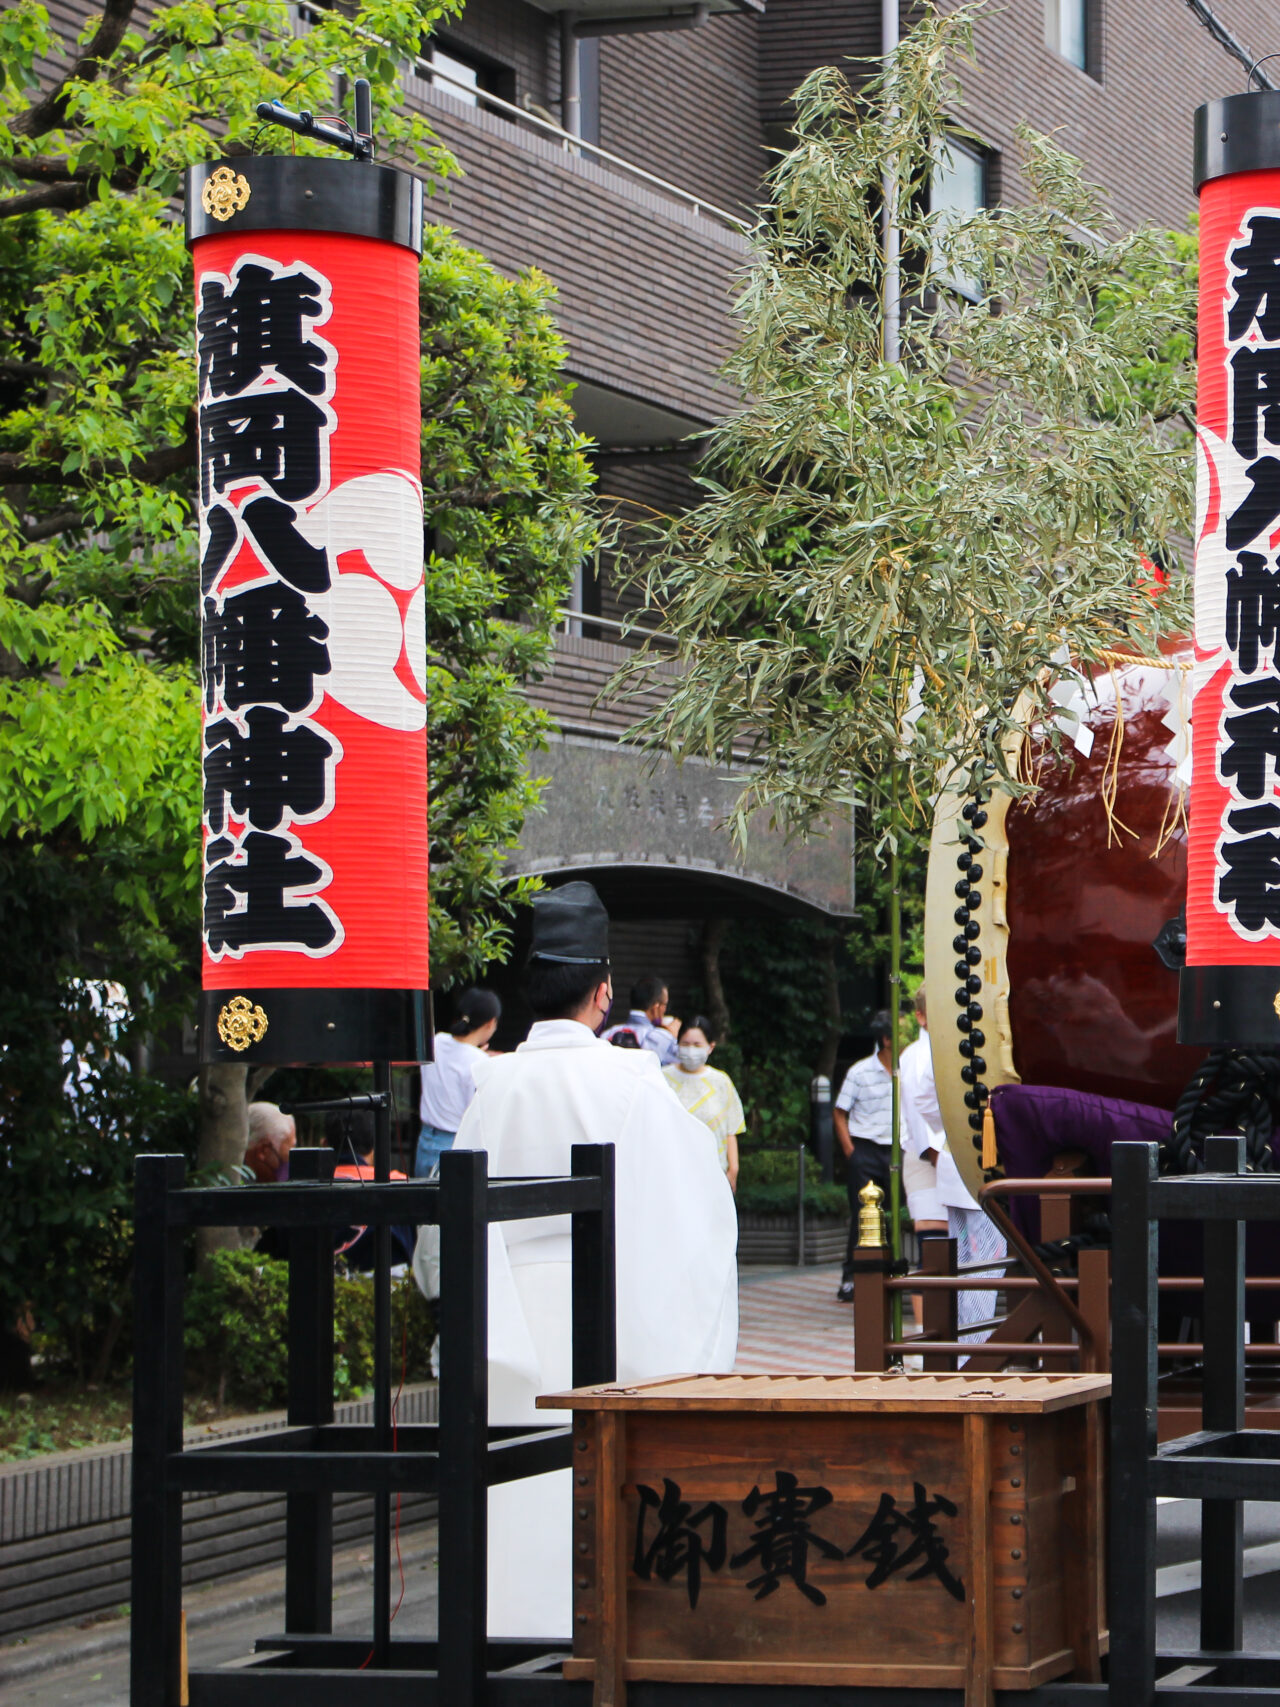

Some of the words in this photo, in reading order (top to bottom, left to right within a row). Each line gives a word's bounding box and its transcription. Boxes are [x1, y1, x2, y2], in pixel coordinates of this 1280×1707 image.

[198, 262, 339, 954] 旗岡八幡神社
[633, 1470, 966, 1610] 御賽銭
